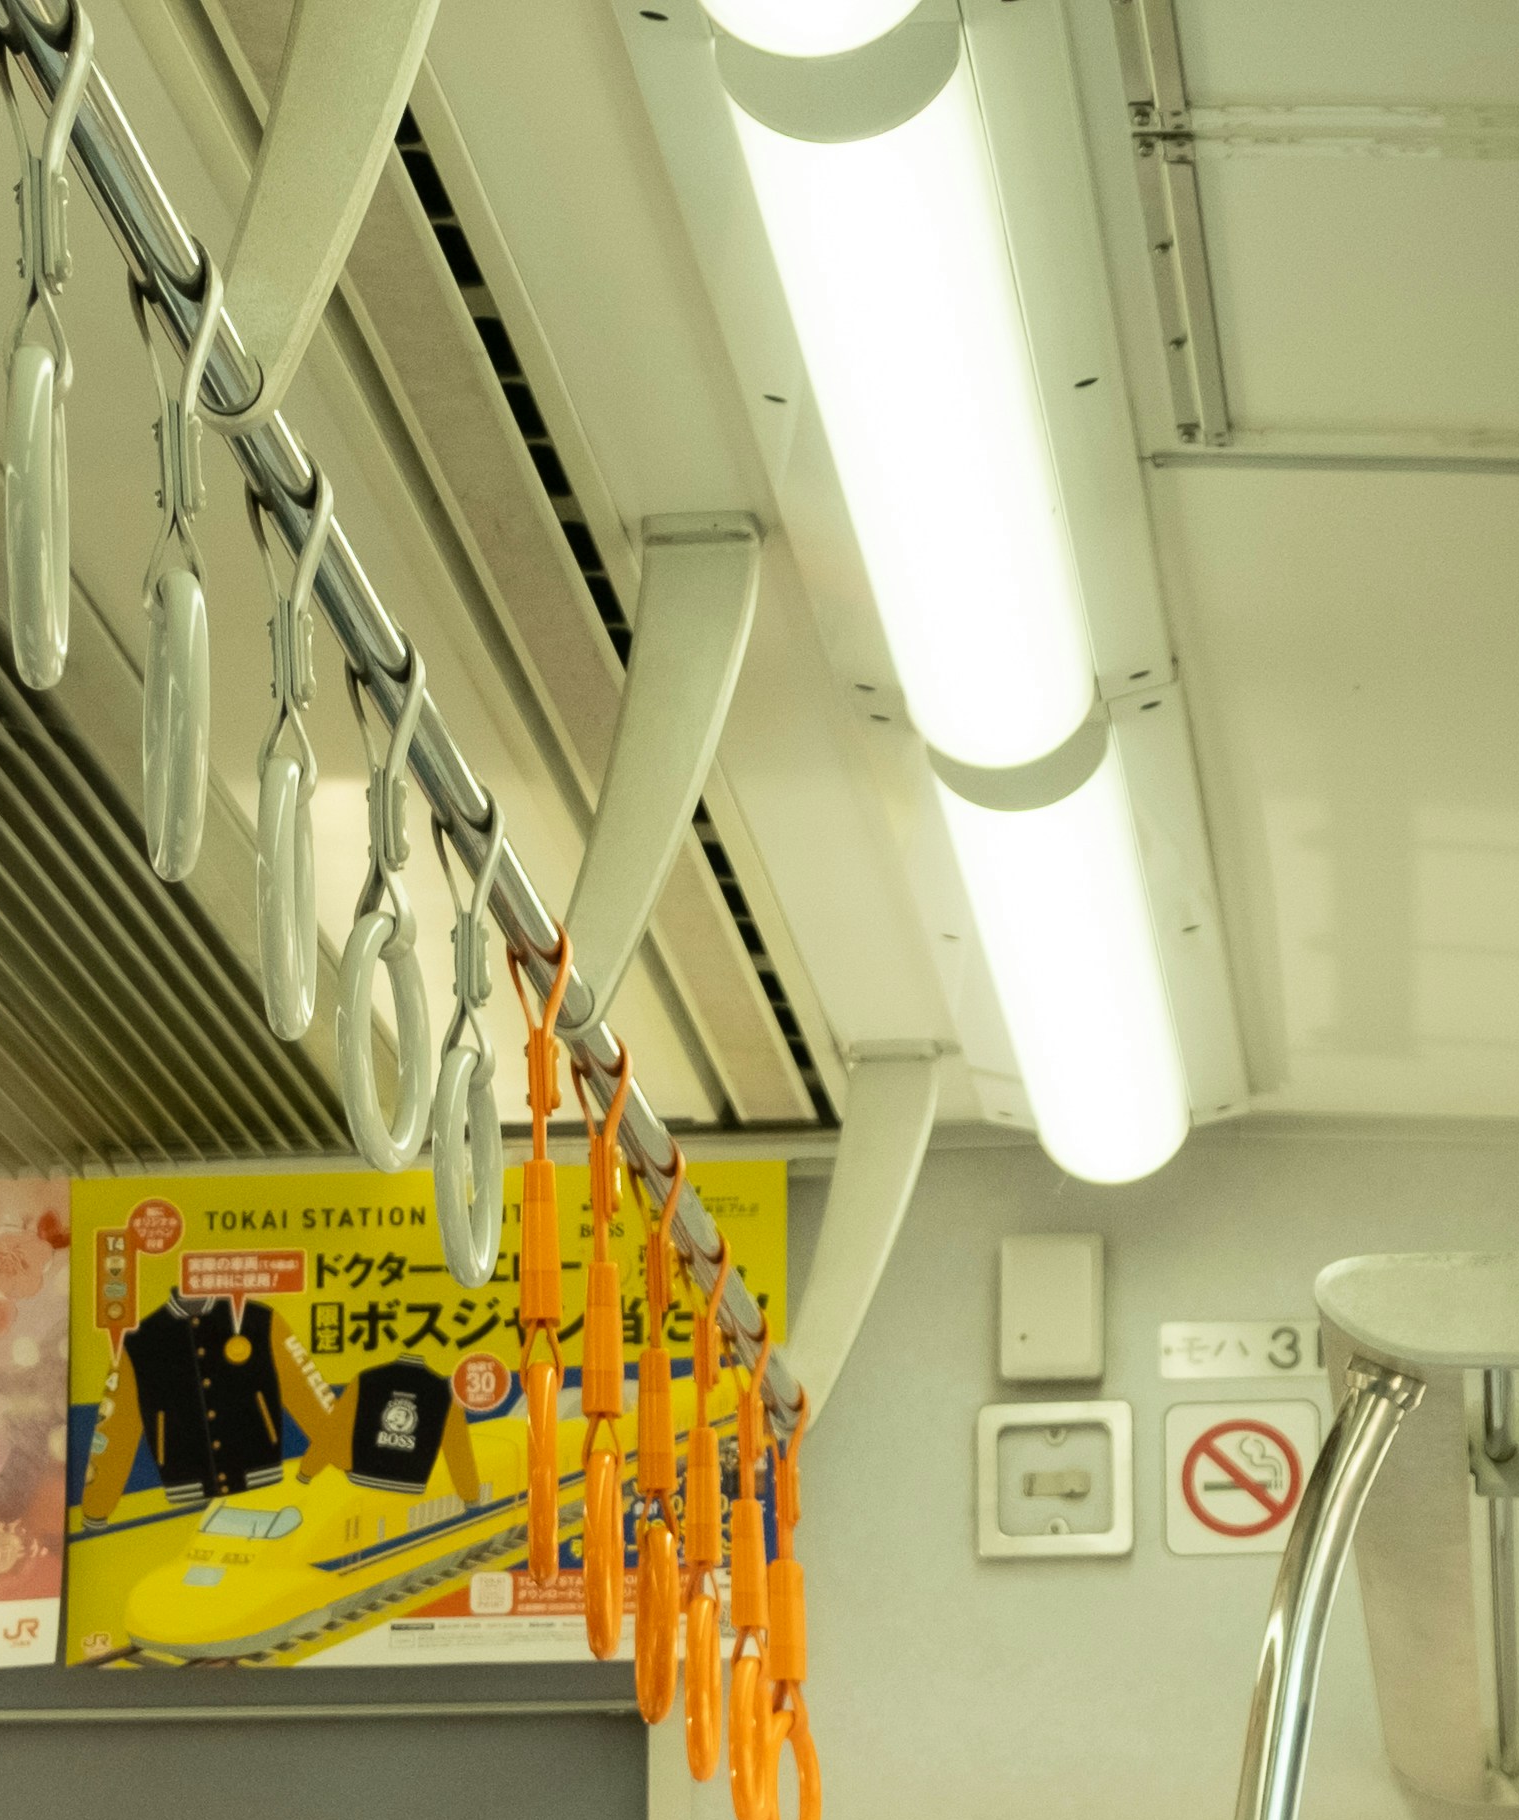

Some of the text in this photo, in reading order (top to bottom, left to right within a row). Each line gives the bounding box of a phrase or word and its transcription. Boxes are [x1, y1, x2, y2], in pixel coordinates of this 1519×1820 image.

[205, 1207, 426, 1231] TOKAI STATION
[580, 1223, 624, 1238] BSS
[106, 1236, 125, 1251] T4
[316, 1304, 340, 1352] 限定
[1174, 1336, 1248, 1364] モハ
[466, 1374, 497, 1393] 30
[376, 1432, 416, 1450] BOSS
[4, 1617, 40, 1640] JR
